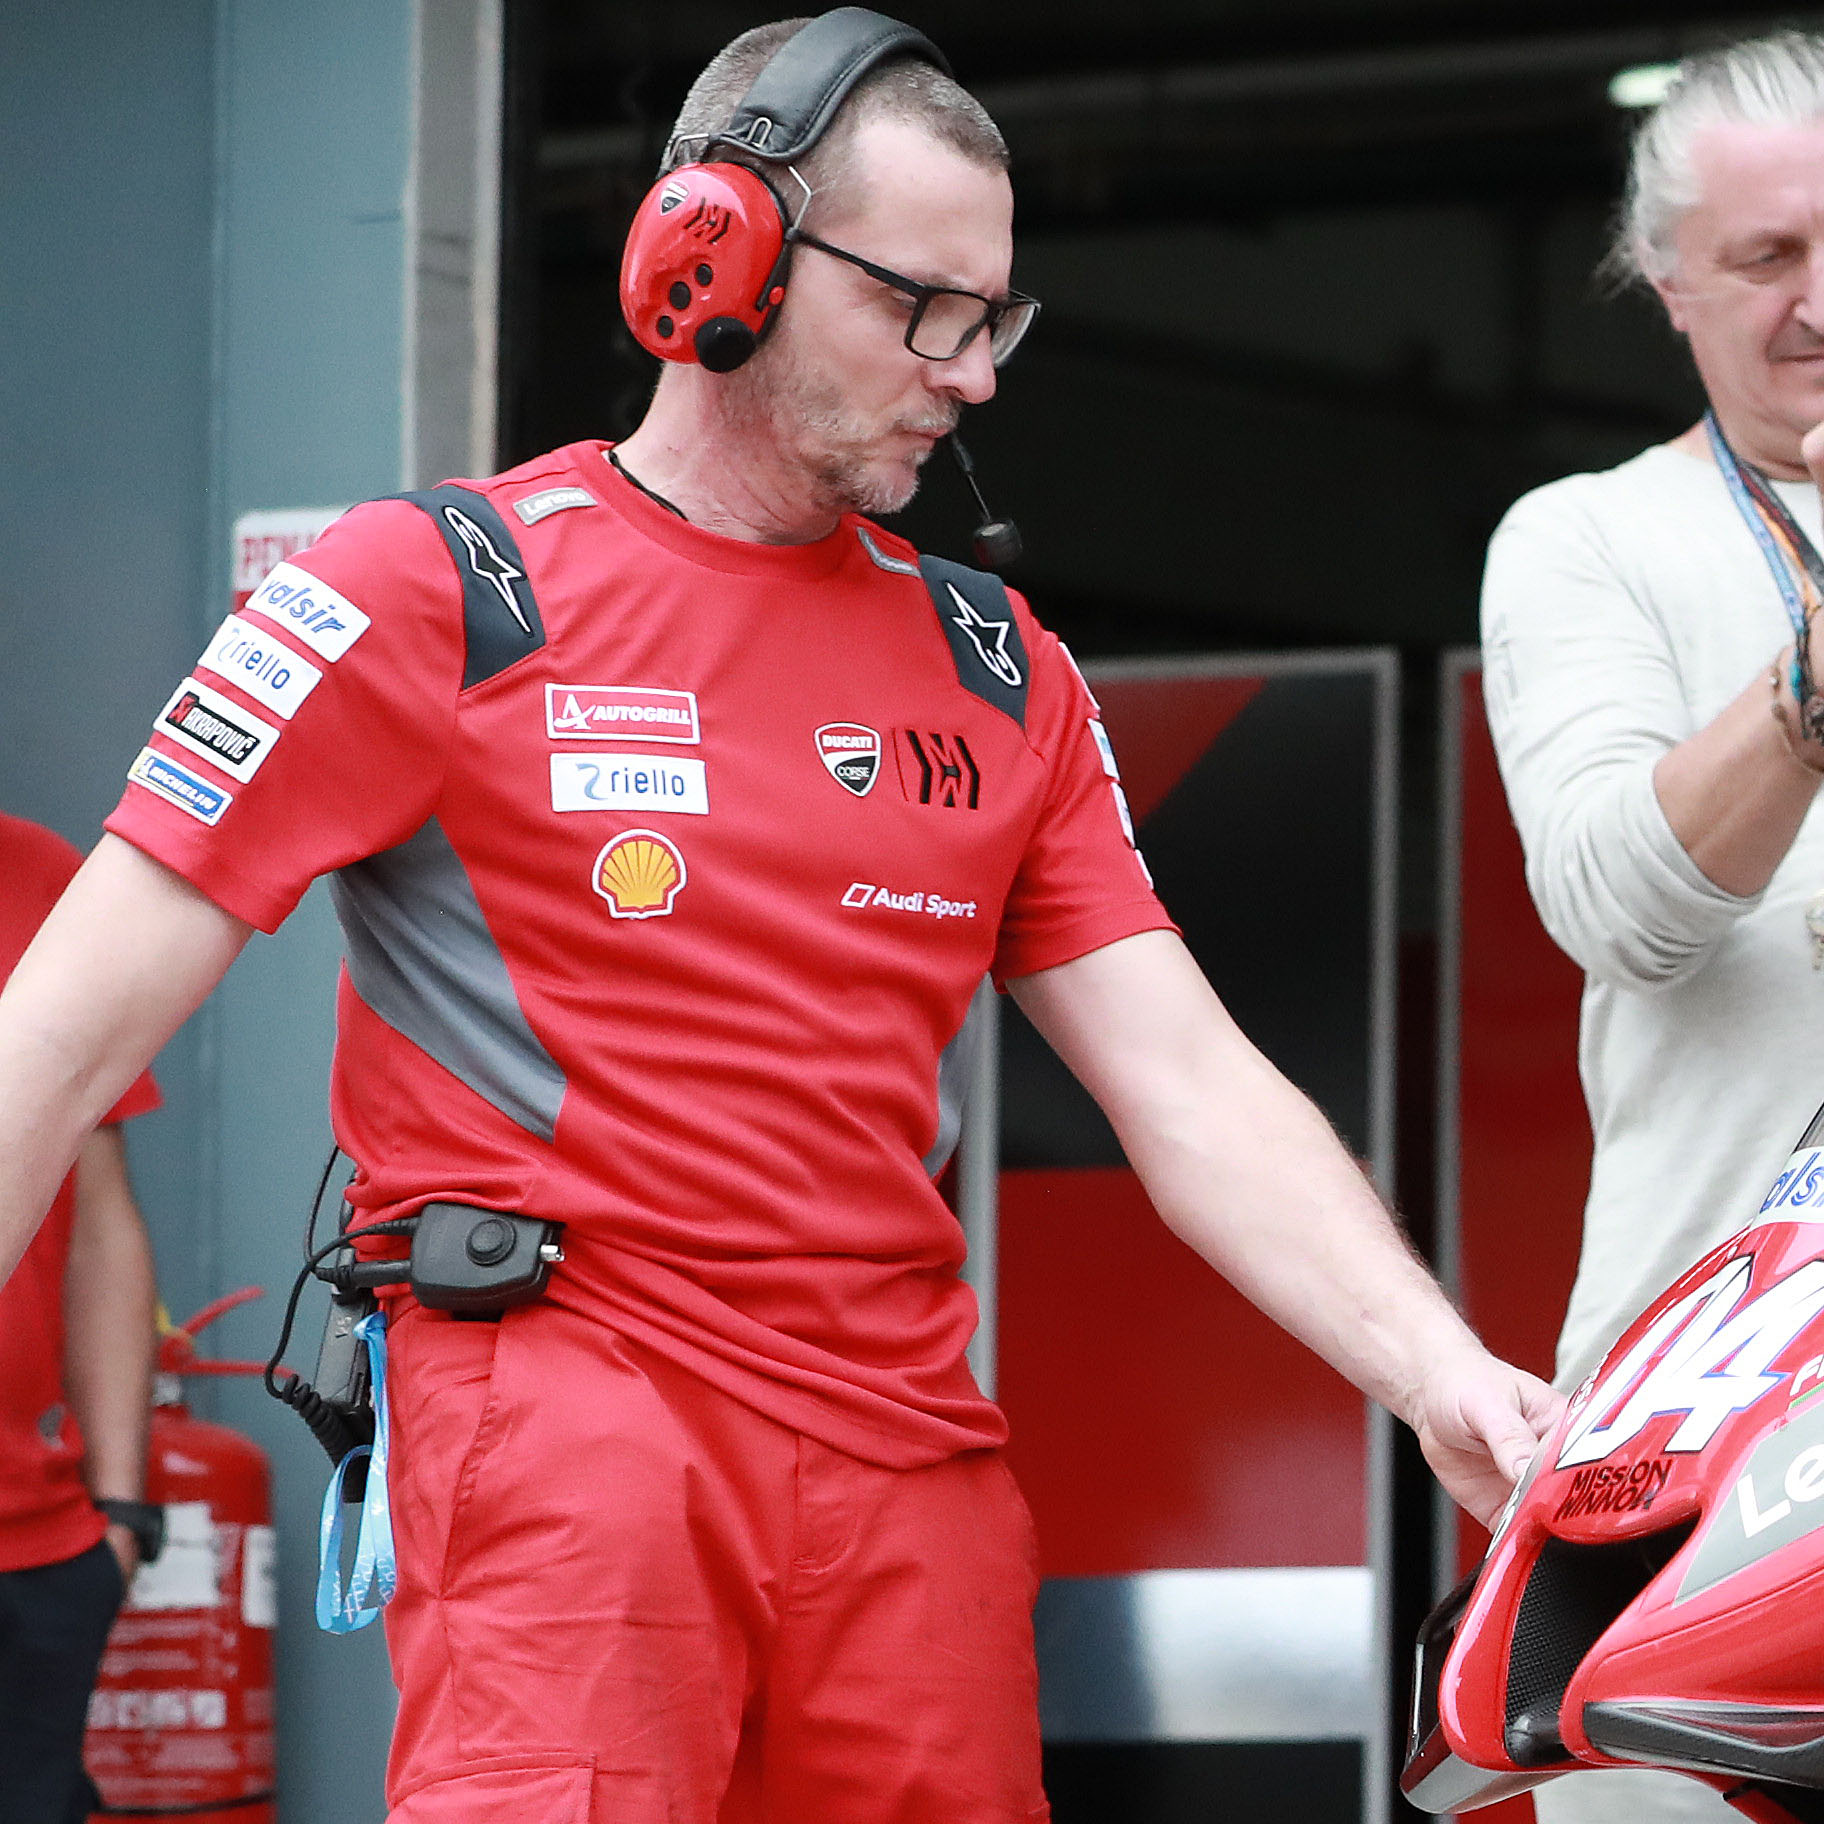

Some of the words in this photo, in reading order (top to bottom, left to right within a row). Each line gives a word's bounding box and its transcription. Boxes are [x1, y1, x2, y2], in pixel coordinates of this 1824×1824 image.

[524, 490, 586, 517] Lenovo
[258, 580, 347, 634] valsir
[230, 641, 291, 690] riello
[592, 704, 691, 725] AUTOGRILL
[821, 733, 874, 750] DUCATI
[610, 767, 685, 797] riello
[837, 764, 871, 779] CORSE
[149, 763, 218, 811] MICHELIN
[872, 888, 923, 912] Audi
[925, 894, 977, 919] Sport
[1571, 1459, 1673, 1497] MISSION
